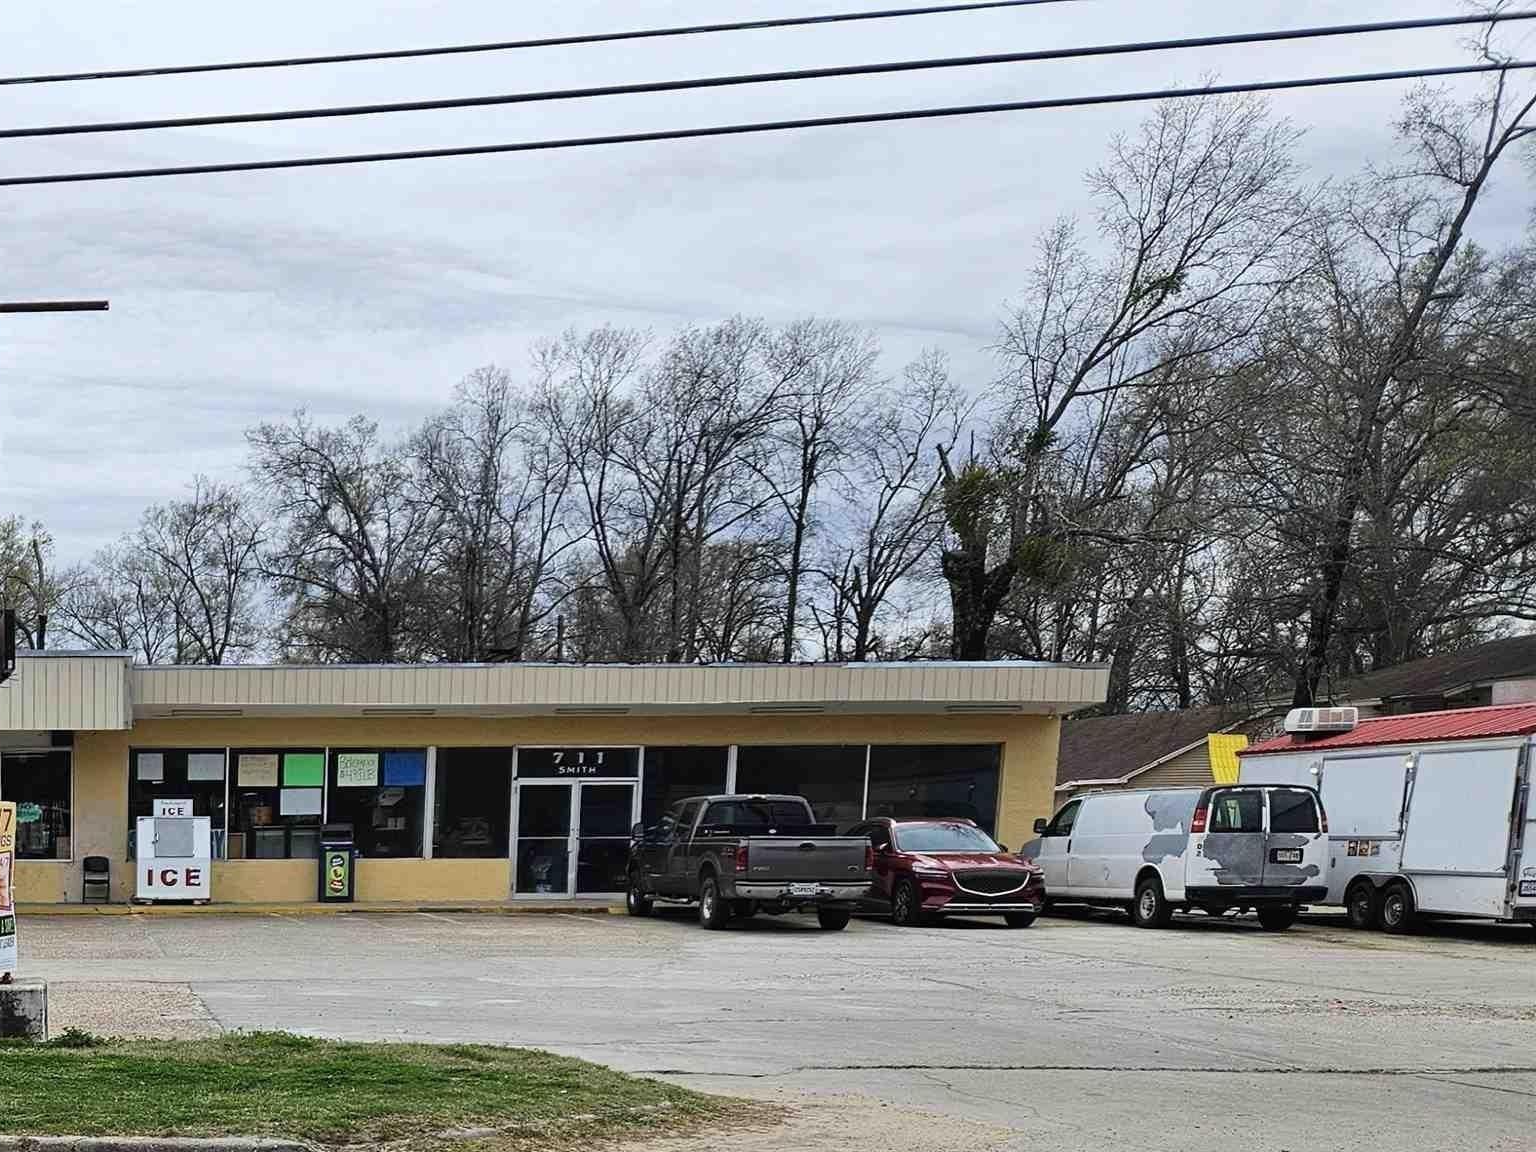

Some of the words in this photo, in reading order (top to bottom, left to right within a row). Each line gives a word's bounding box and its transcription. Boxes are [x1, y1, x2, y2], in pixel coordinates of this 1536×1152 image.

[558, 766, 596, 774] SMITH
[162, 807, 184, 816] ICE
[147, 868, 201, 886] ICE
